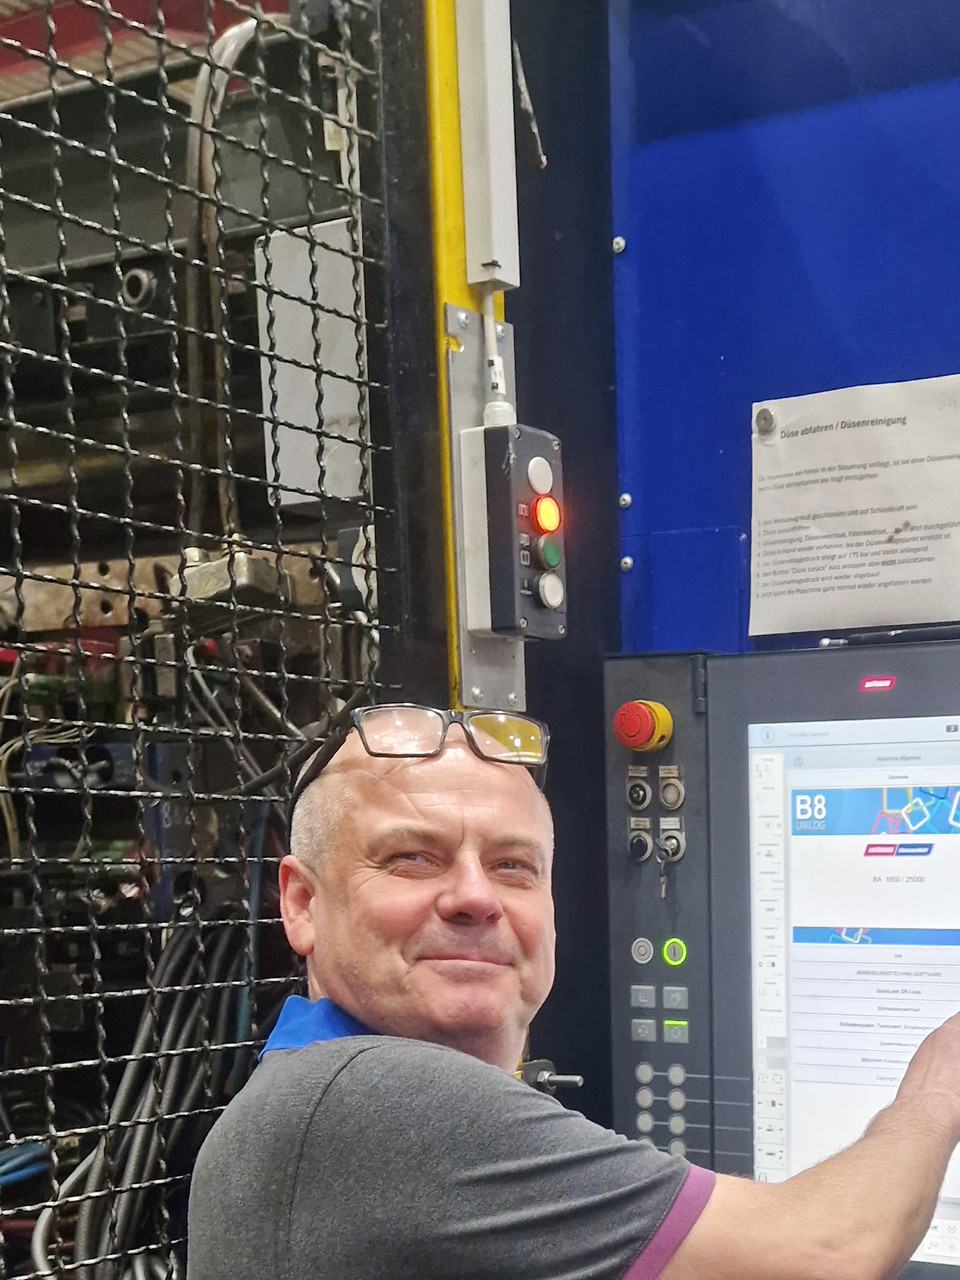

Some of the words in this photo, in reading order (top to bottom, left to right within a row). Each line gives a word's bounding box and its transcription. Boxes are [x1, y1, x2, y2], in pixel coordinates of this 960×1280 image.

[780, 429, 799, 439] Düse
[800, 423, 834, 436] abfahren
[840, 416, 907, 429] Düsenreinigung
[795, 794, 827, 820] B8
